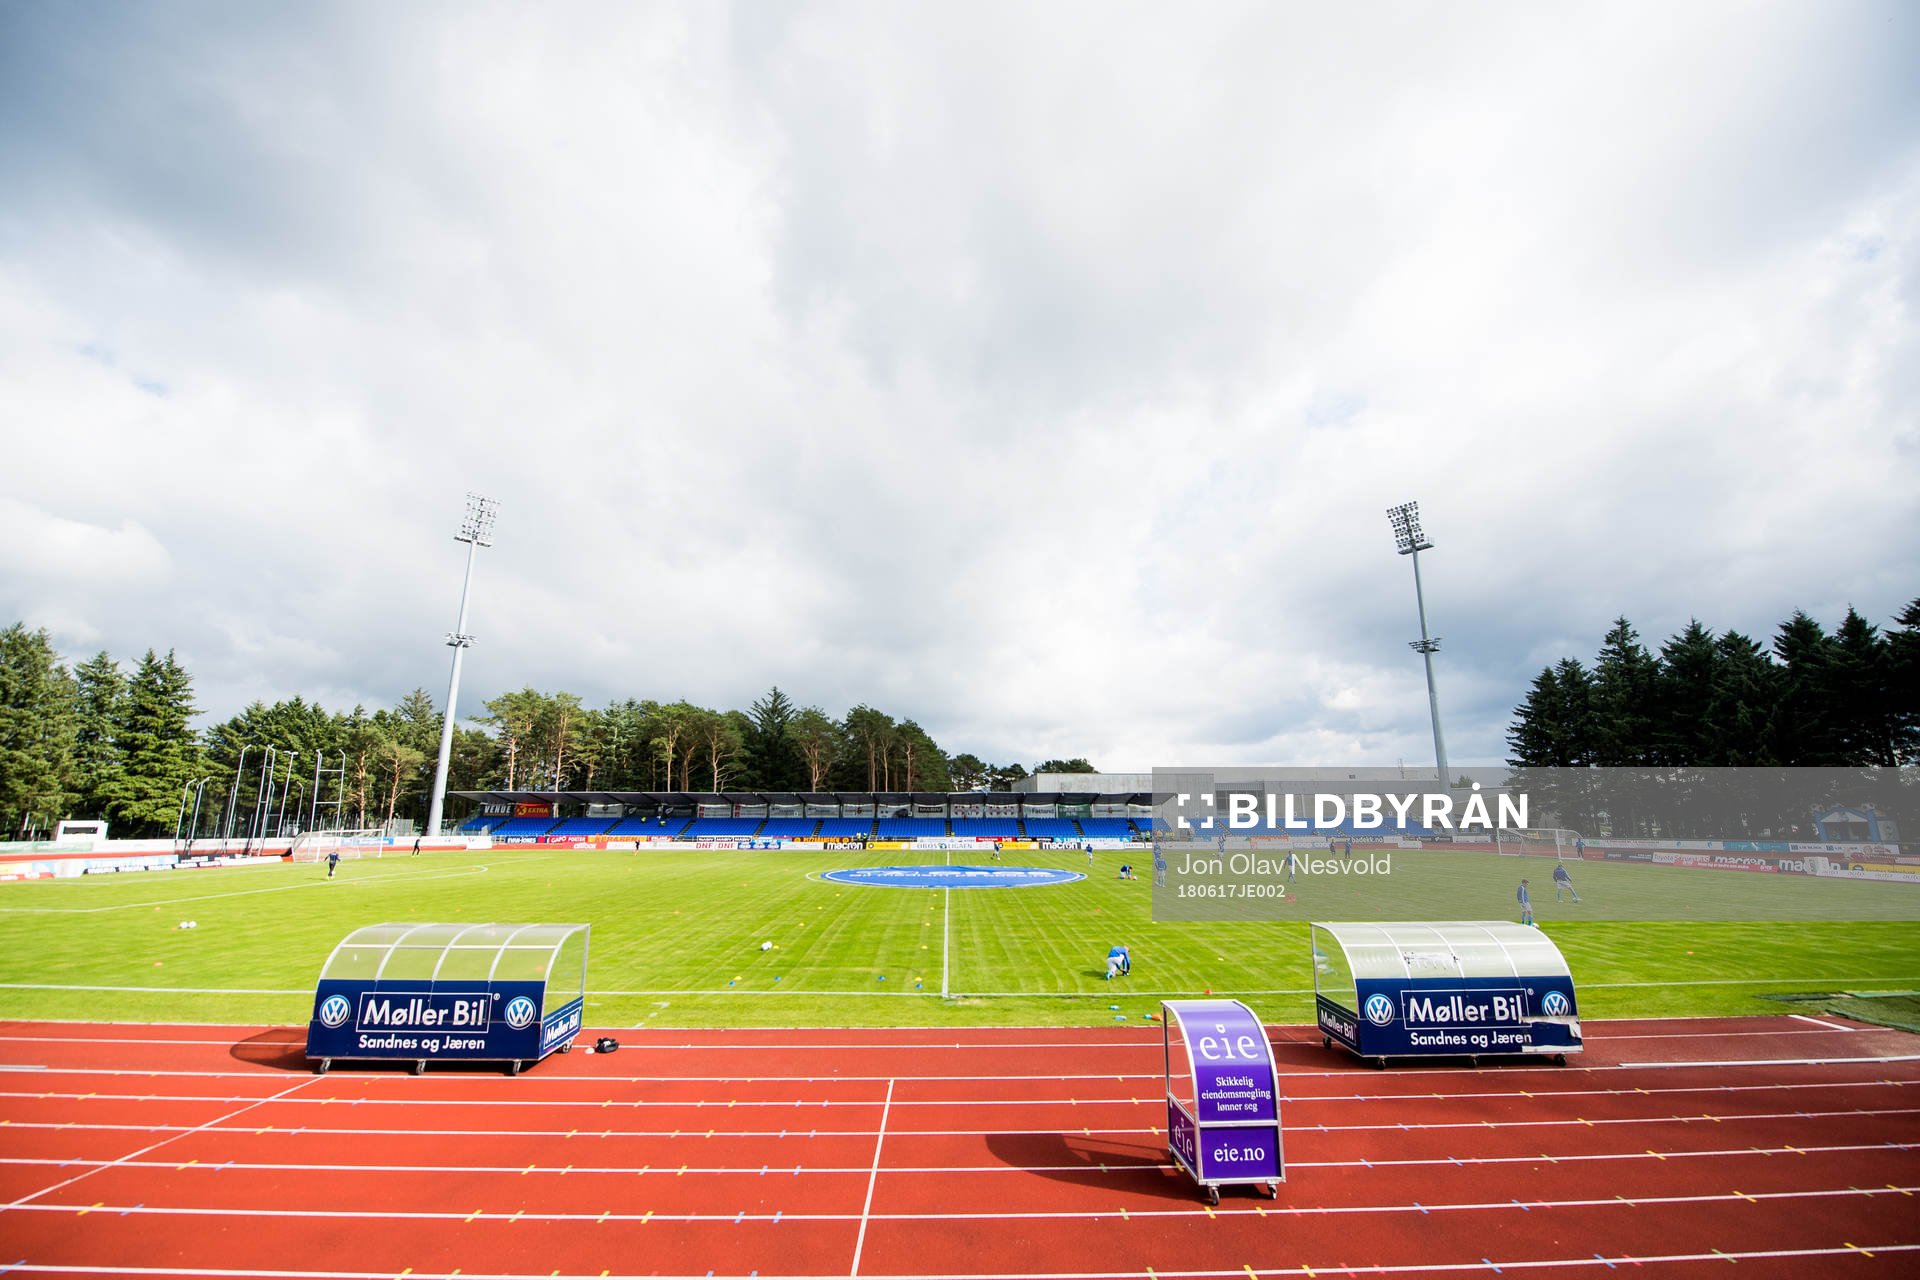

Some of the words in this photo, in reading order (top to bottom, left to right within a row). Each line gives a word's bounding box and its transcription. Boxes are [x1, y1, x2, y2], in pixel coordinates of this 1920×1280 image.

[484, 805, 512, 814] VENUE
[827, 842, 864, 850] macron
[1042, 842, 1079, 850] macron
[1714, 856, 1767, 866] macron
[362, 998, 450, 1026] Møller
[453, 998, 486, 1026] Bil
[1409, 996, 1489, 1024] Møller
[1494, 995, 1523, 1024] Bil
[358, 1034, 418, 1050] Sandnes
[422, 1037, 439, 1052] og
[442, 1035, 486, 1050] Jæren
[1200, 1023, 1259, 1060] eie
[1410, 1031, 1467, 1046] Sandnes
[1472, 1033, 1489, 1048] og
[1491, 1031, 1533, 1046] Jæren
[1216, 1076, 1254, 1088] Skikkelig
[1201, 1088, 1272, 1101] eiendomsmegling
[1217, 1101, 1242, 1112] lønner
[1244, 1102, 1258, 1113] seg
[1175, 1117, 1194, 1163] eie
[1213, 1143, 1265, 1162] eie.no
